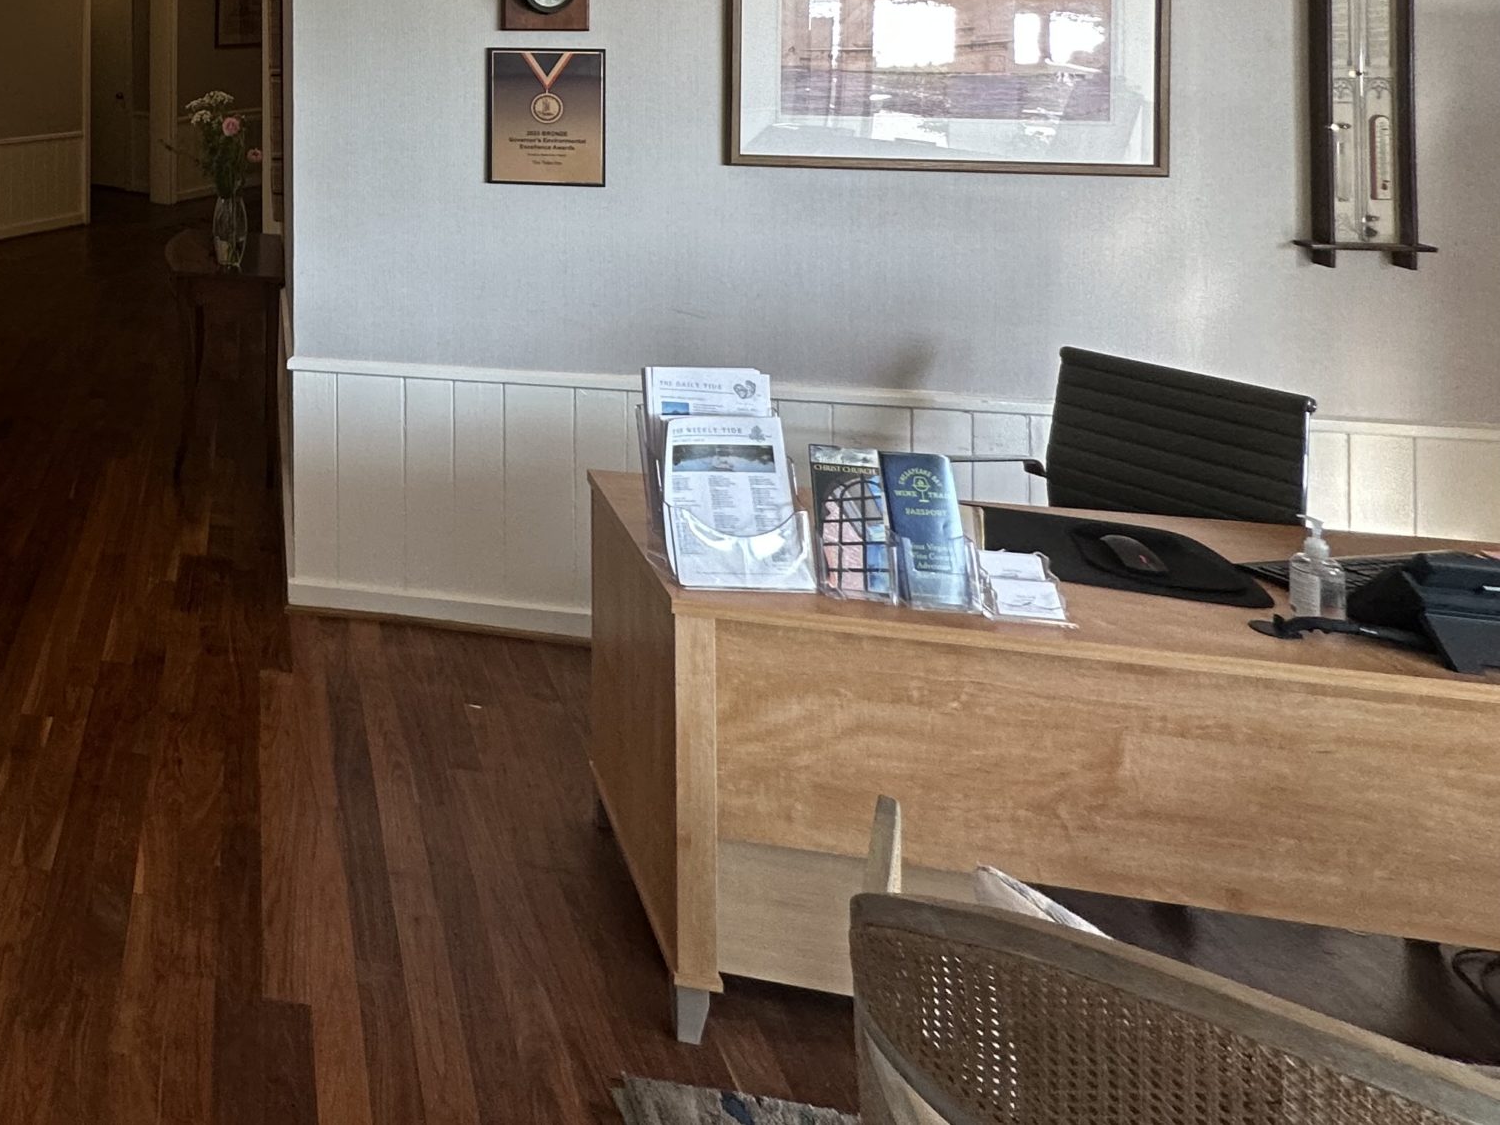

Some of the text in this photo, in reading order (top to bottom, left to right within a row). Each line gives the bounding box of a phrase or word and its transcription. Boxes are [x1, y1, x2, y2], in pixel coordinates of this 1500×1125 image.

[675, 380, 700, 389] DAILY
[685, 426, 718, 434] WEEKLY
[721, 426, 743, 434] TIDE
[813, 463, 878, 475] CHRIST CHURCH
[893, 489, 918, 497] WINE
[905, 507, 948, 516] PASSPORT
